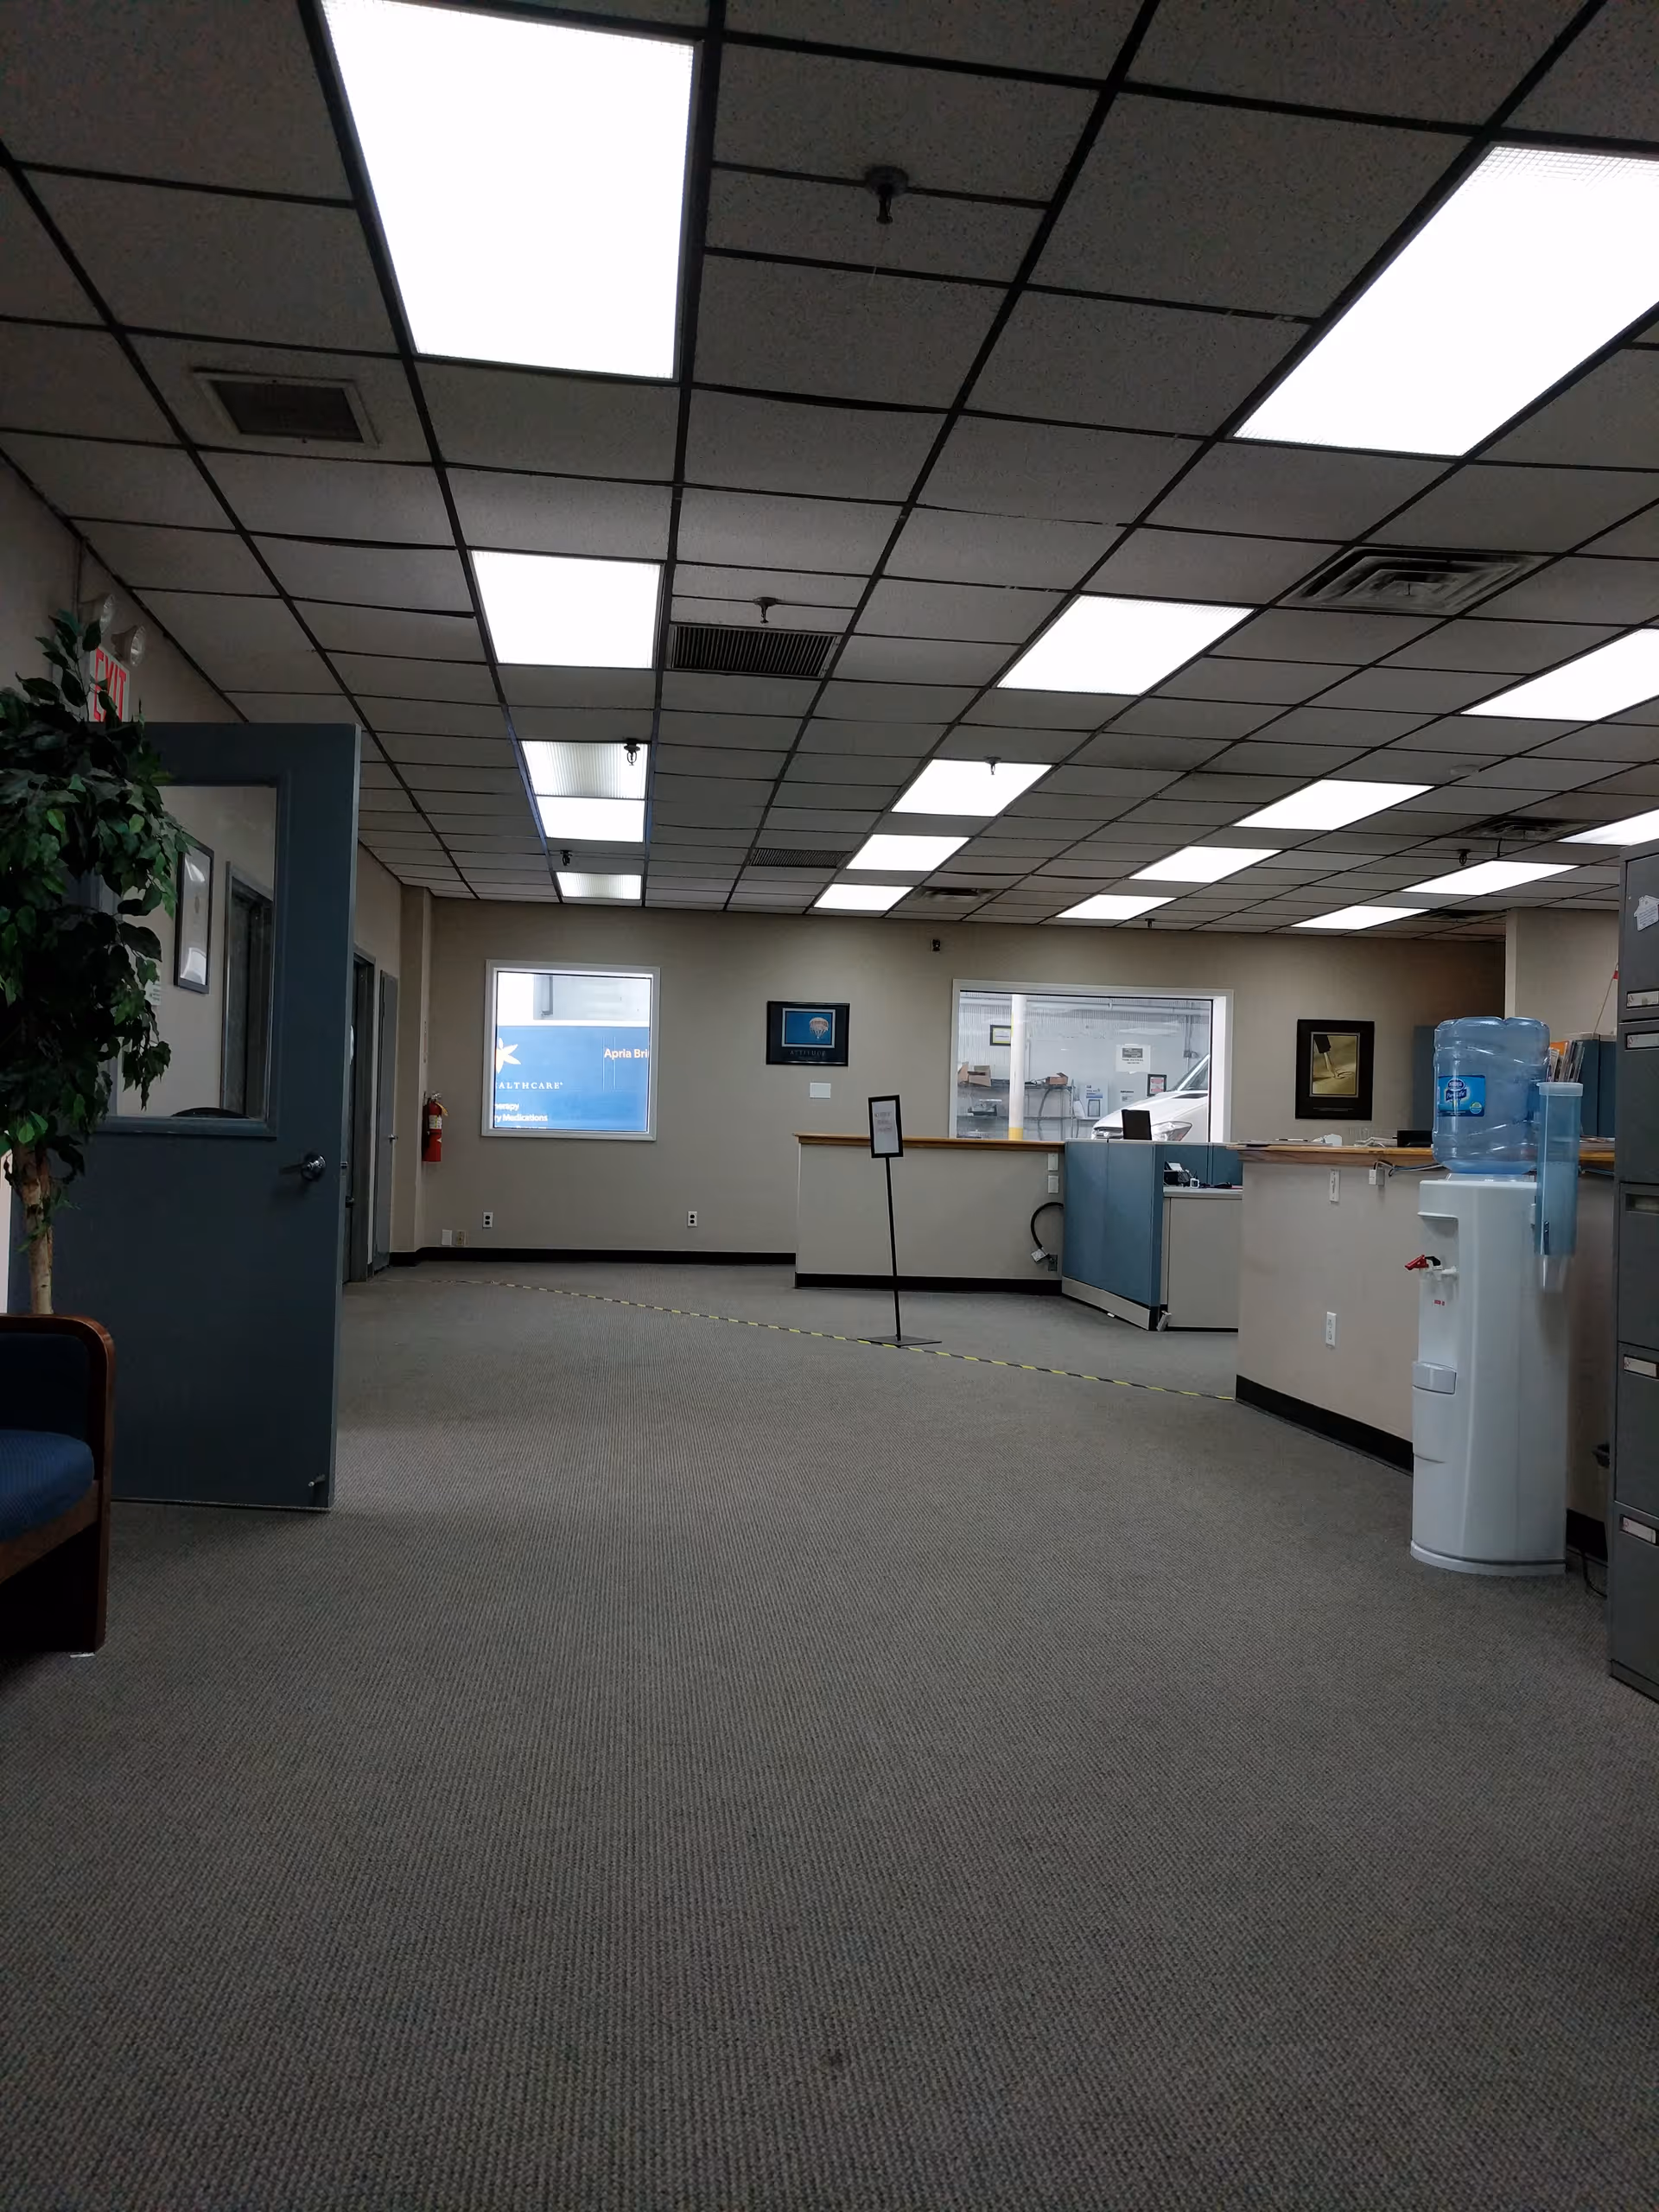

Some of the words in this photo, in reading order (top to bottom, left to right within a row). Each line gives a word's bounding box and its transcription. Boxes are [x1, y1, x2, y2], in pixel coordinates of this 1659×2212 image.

[604, 1048, 632, 1060] Apria
[633, 1048, 649, 1058] Bri
[496, 1081, 561, 1090] ALTHCARE
[502, 1113, 548, 1122] Medications
